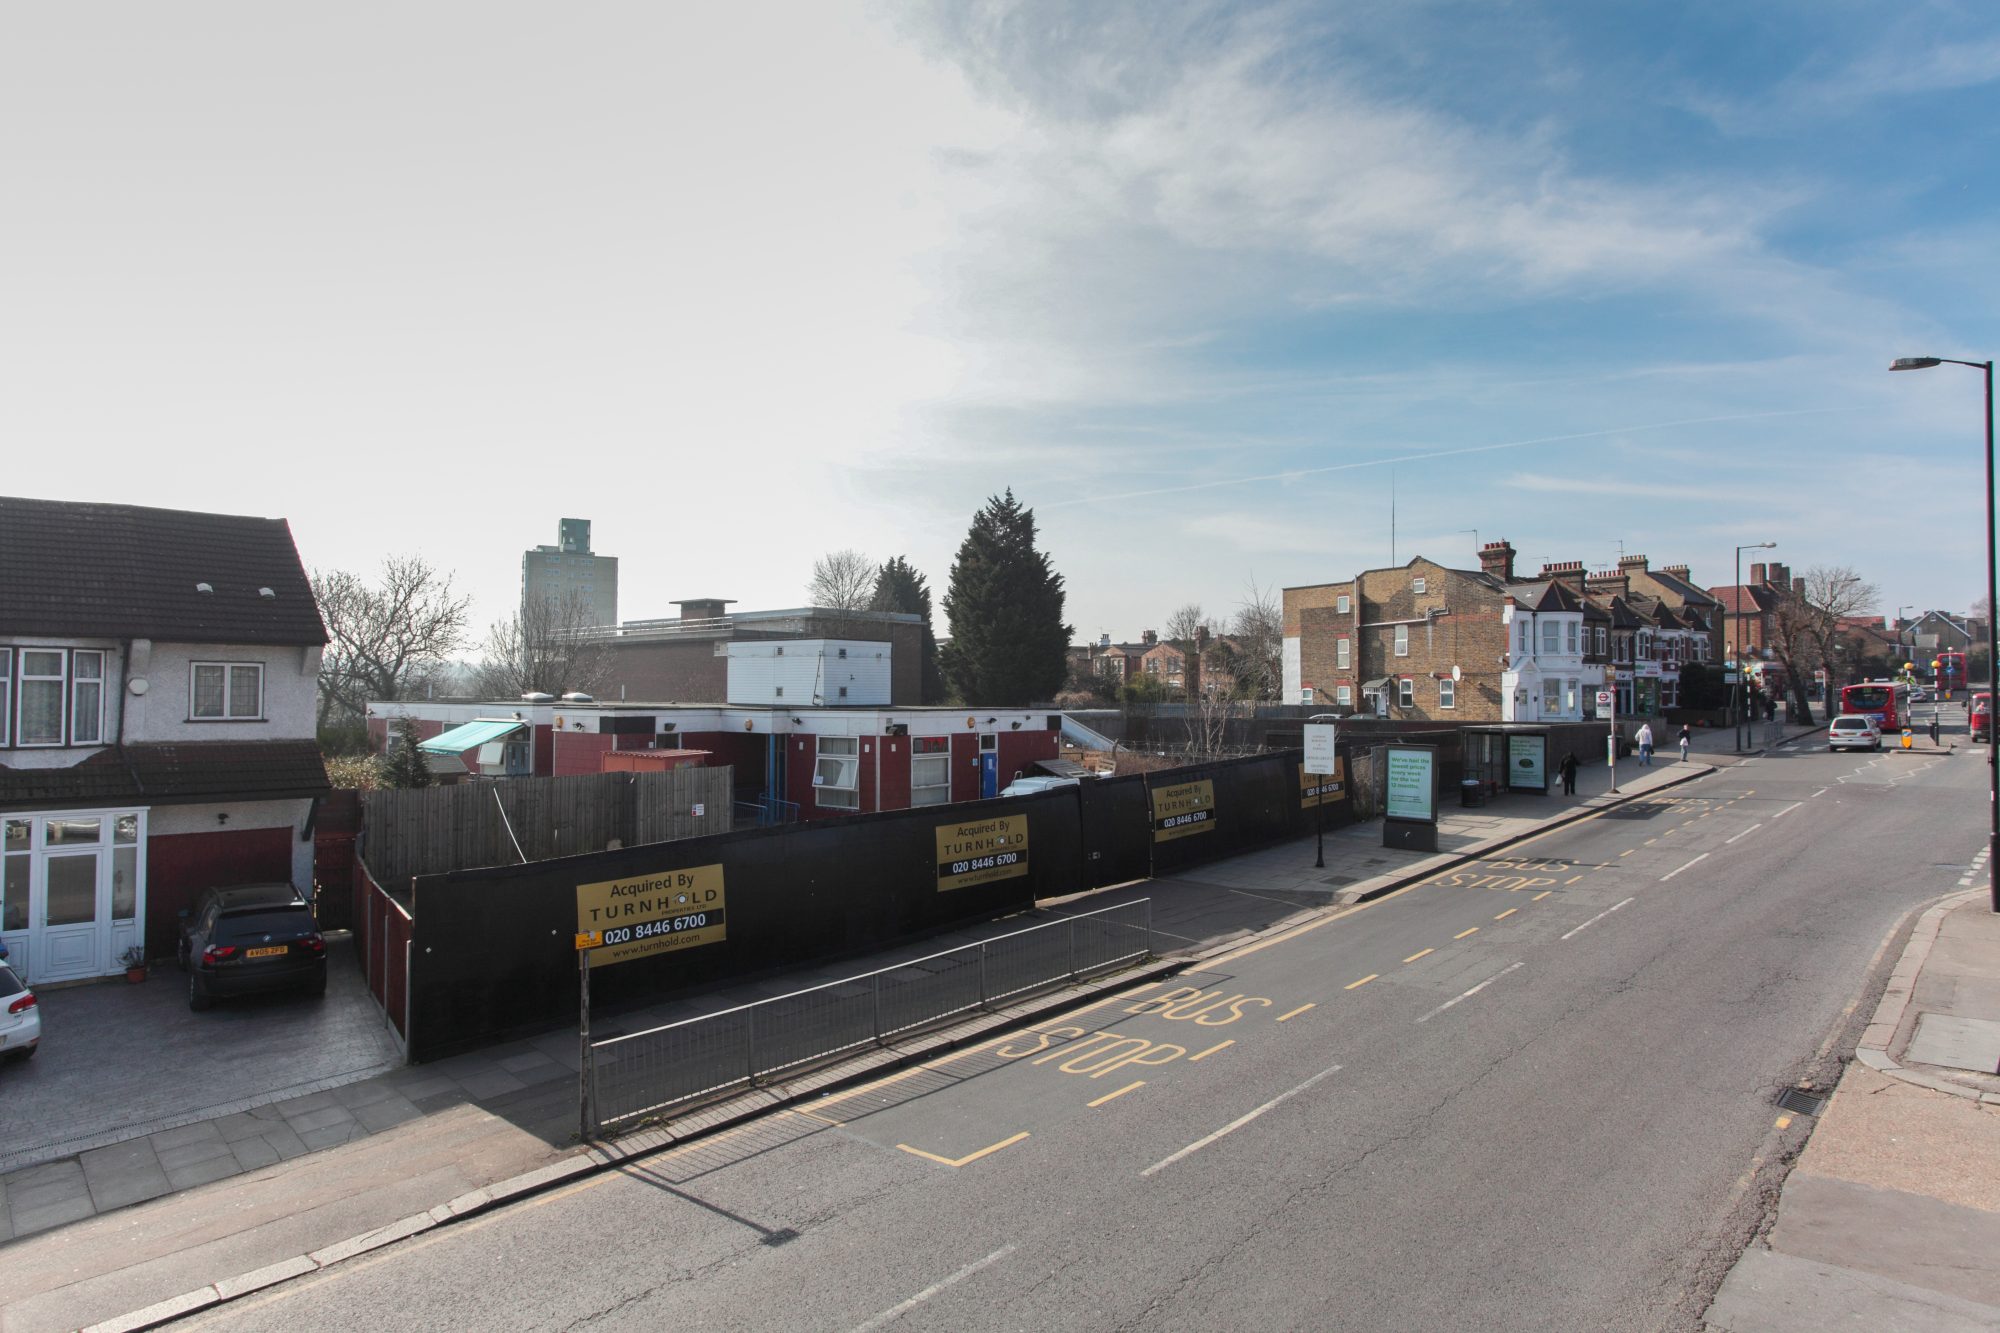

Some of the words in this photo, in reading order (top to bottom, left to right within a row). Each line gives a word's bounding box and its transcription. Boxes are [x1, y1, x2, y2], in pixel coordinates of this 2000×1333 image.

[1166, 784, 1193, 799] Acquired
[1194, 784, 1202, 795] By
[957, 821, 996, 837] Acquired
[999, 820, 1010, 833] By
[1164, 817, 1175, 828] 020
[1177, 814, 1192, 825] 8446
[1193, 811, 1207, 821] 6700
[944, 833, 1024, 855] TURNHOLD
[952, 861, 969, 874] 020
[971, 856, 994, 870] 8446
[997, 852, 1017, 866] 6700
[1485, 856, 1580, 872] BUS
[610, 875, 672, 898] Acquired
[677, 873, 694, 889] By
[1434, 873, 1558, 892] STOP
[589, 889, 717, 922] TURNHOLD
[605, 927, 630, 945] 020
[635, 920, 670, 938] 8446
[674, 913, 706, 931] 6700
[612, 934, 700, 959] www.turnhold.com
[1122, 986, 1273, 1026] BUS
[995, 1026, 1187, 1079] STOP
